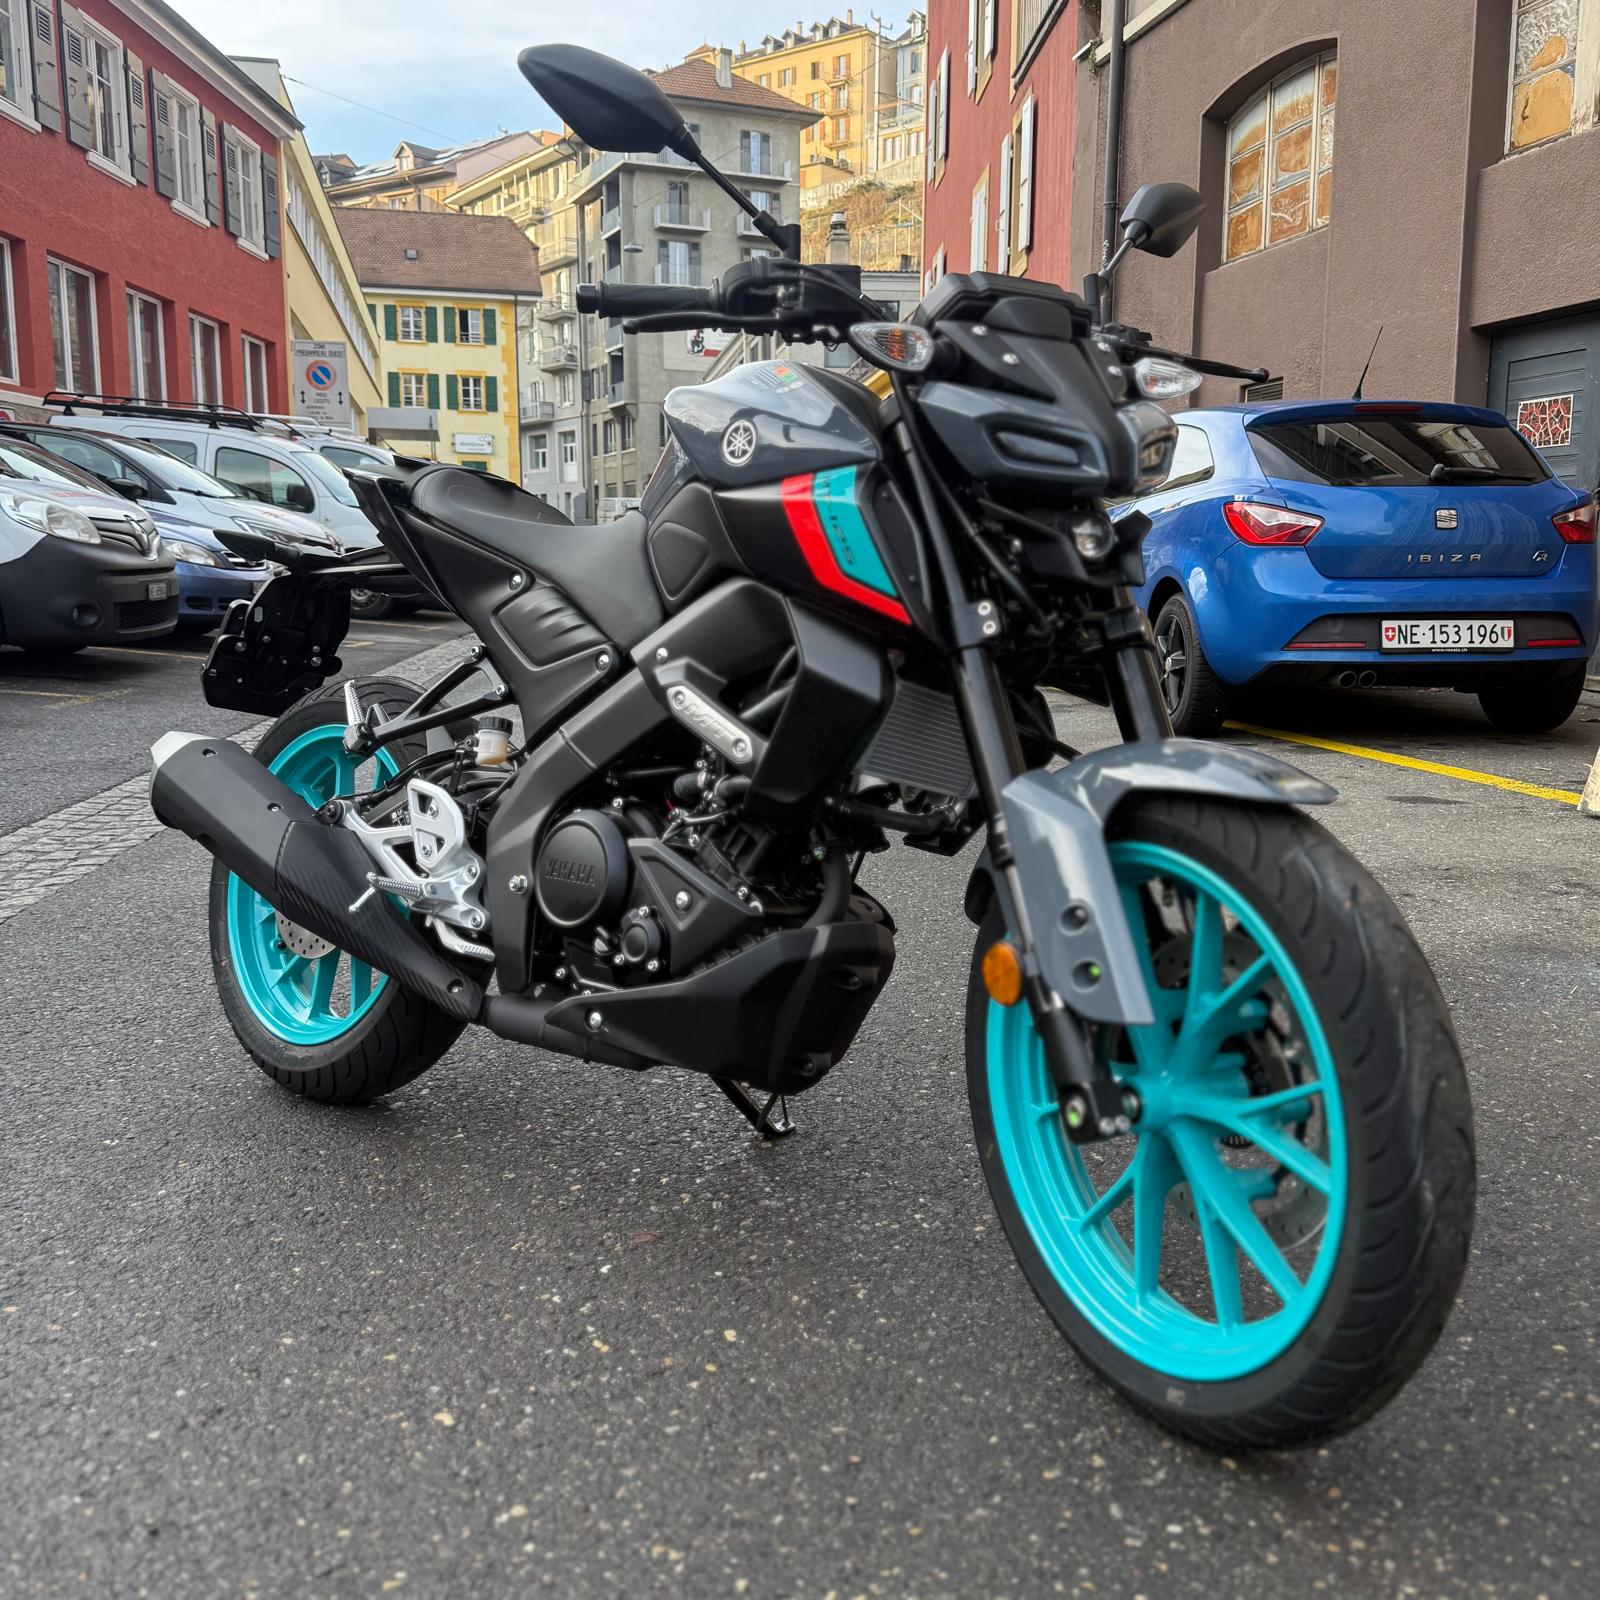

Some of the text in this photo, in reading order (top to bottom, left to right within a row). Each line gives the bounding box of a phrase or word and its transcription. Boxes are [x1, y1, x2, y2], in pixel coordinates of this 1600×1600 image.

[1407, 554, 1482, 563] IBIZA
[684, 702, 737, 739] MT
[544, 859, 596, 887] YAMAHA
